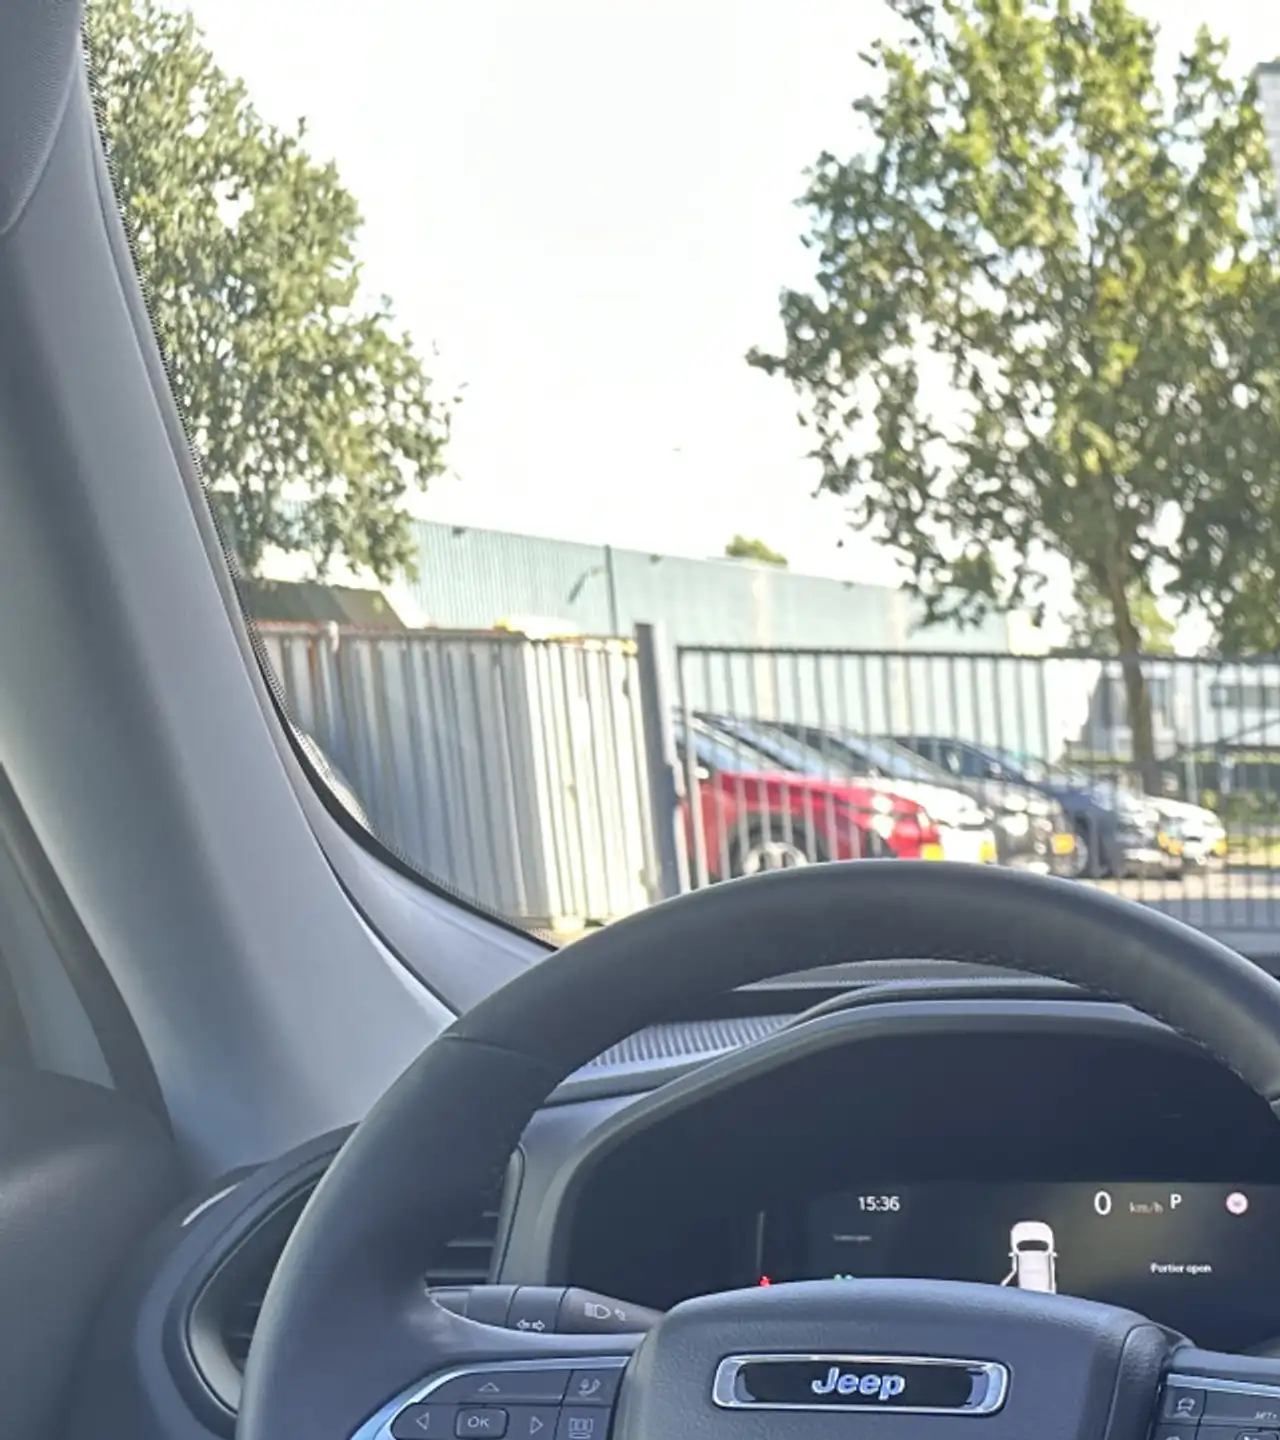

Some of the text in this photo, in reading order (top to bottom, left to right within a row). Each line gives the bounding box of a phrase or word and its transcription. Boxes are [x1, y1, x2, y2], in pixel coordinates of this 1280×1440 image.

[857, 1195, 901, 1212] 15:36
[1094, 1190, 1182, 1216] 0 km/h P
[1186, 1264, 1212, 1276] open
[811, 1367, 905, 1400] Jeep
[467, 1416, 490, 1428] OK
